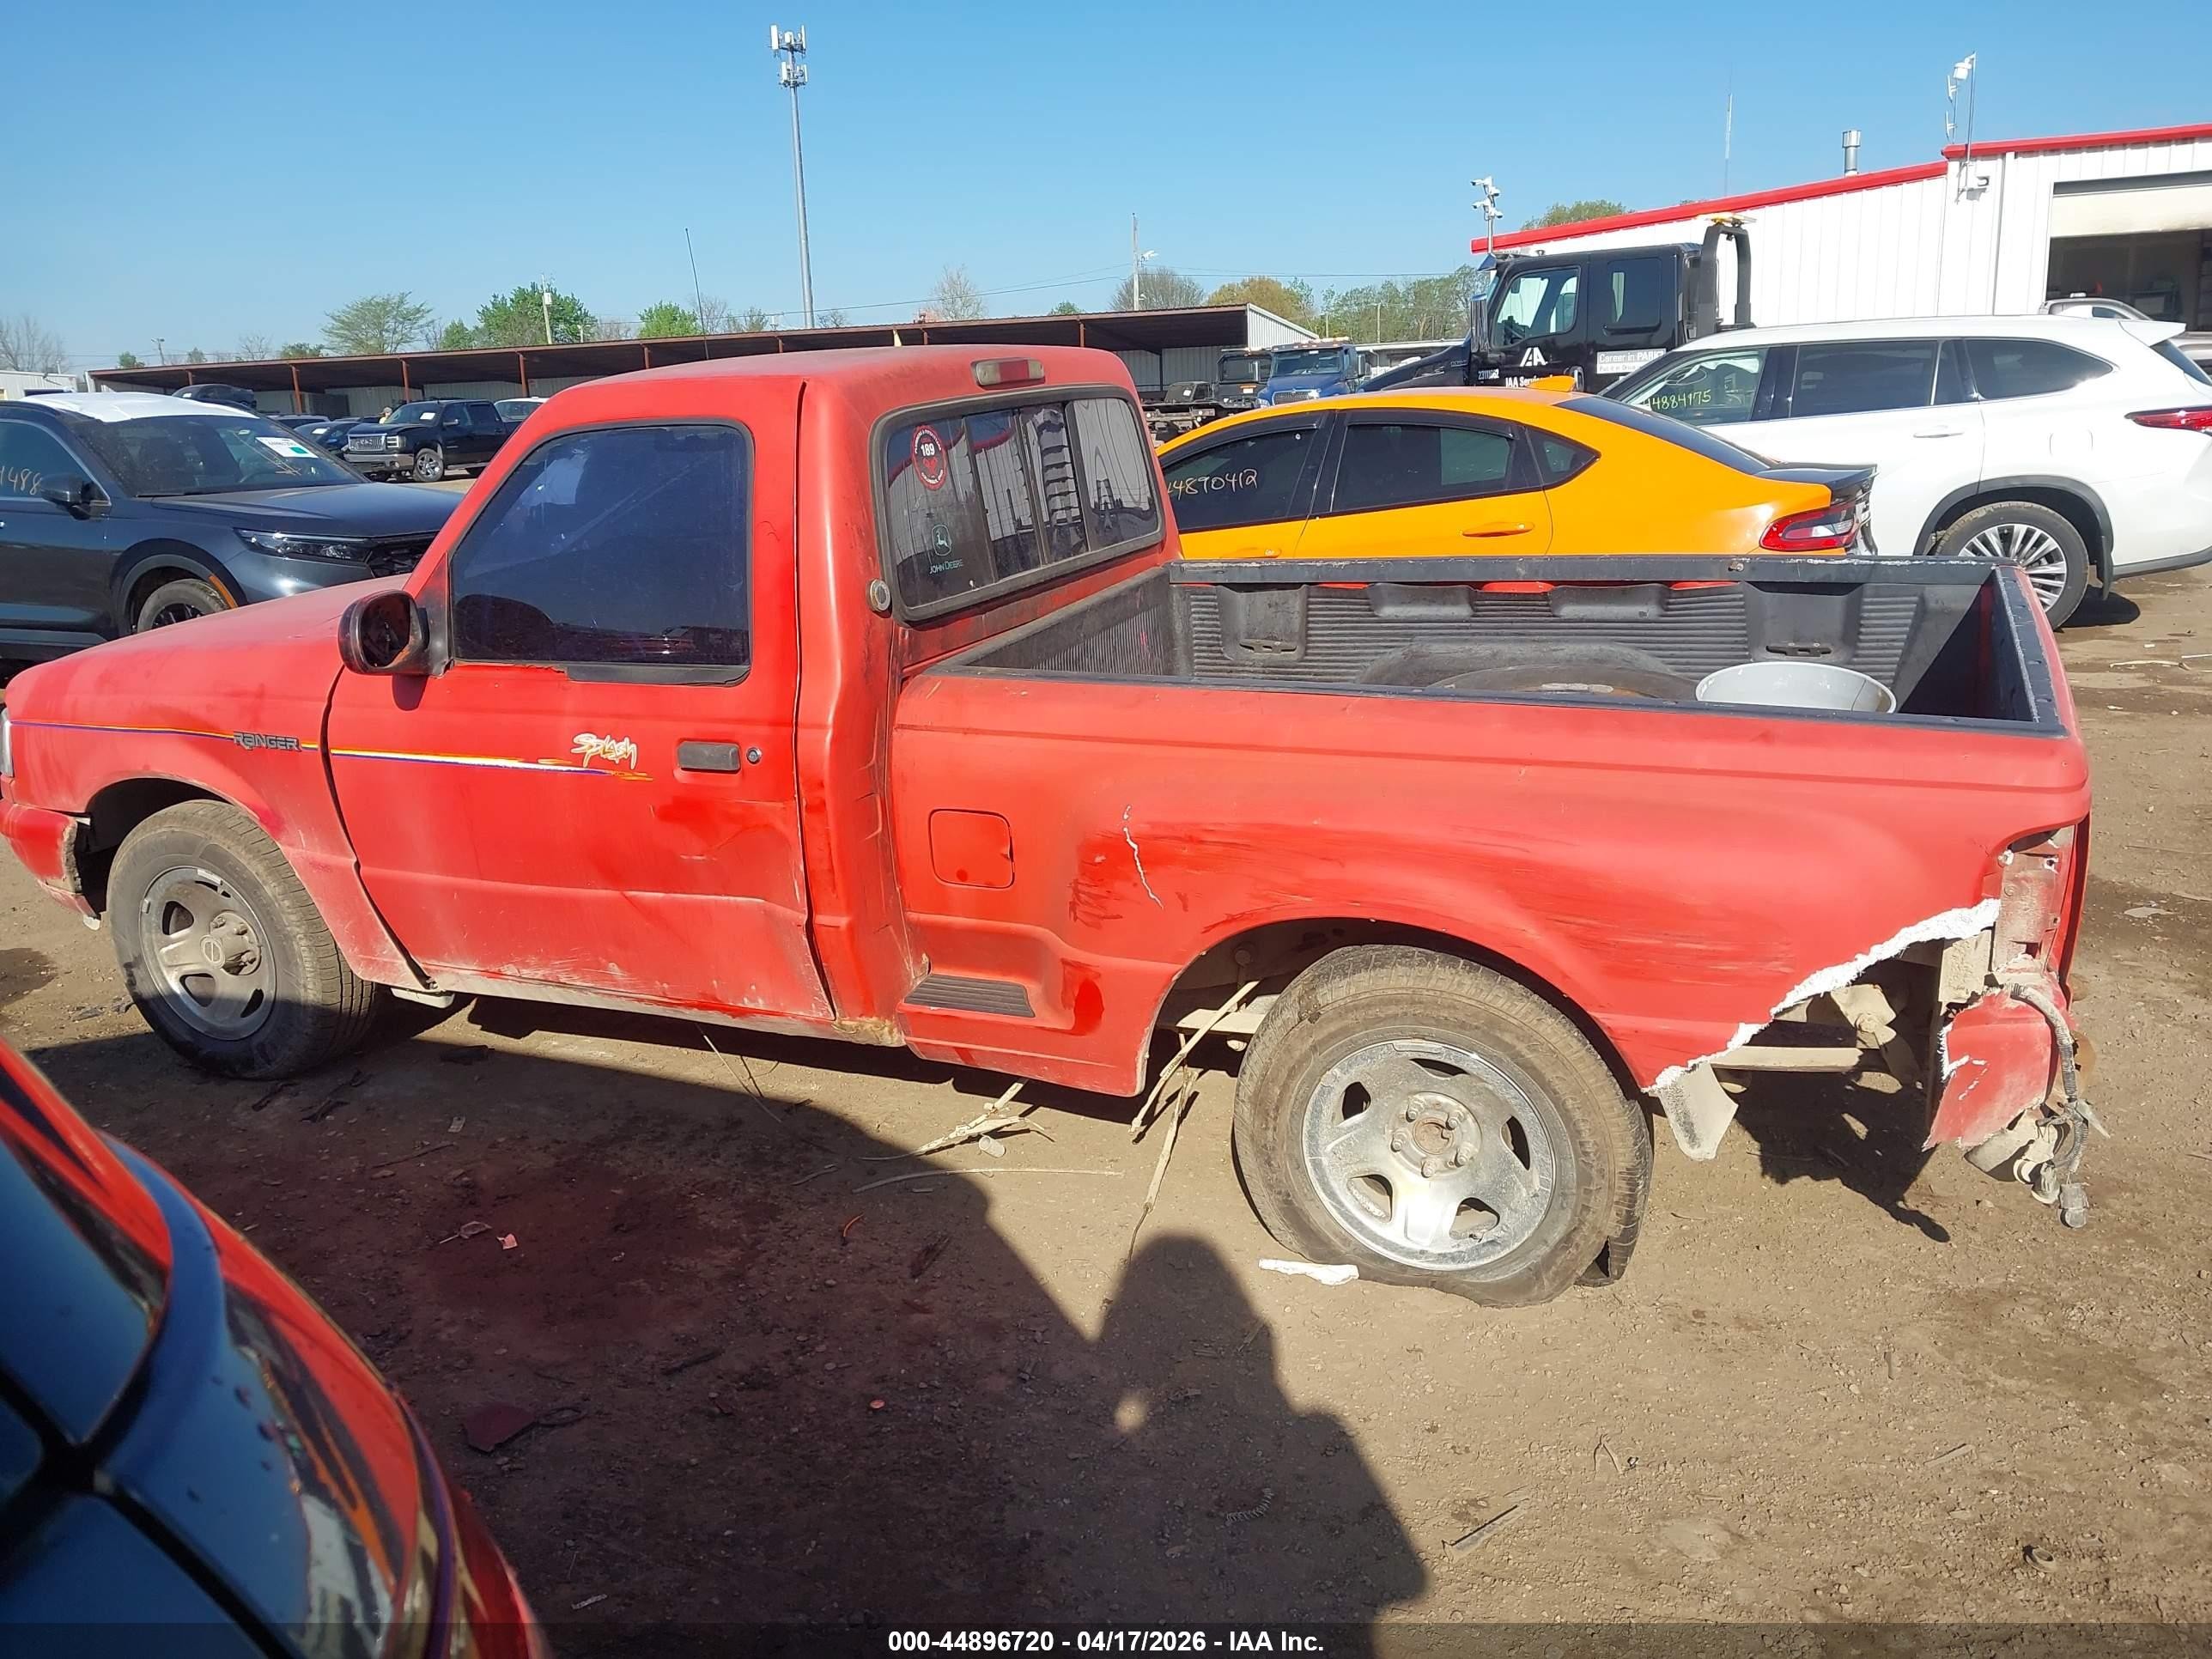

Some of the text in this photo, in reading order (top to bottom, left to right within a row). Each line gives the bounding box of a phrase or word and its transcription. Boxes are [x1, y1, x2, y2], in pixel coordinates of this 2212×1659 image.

[921, 442, 936, 457] 189
[929, 558, 964, 574] JOHN DEERE
[233, 731, 302, 752] RANGER
